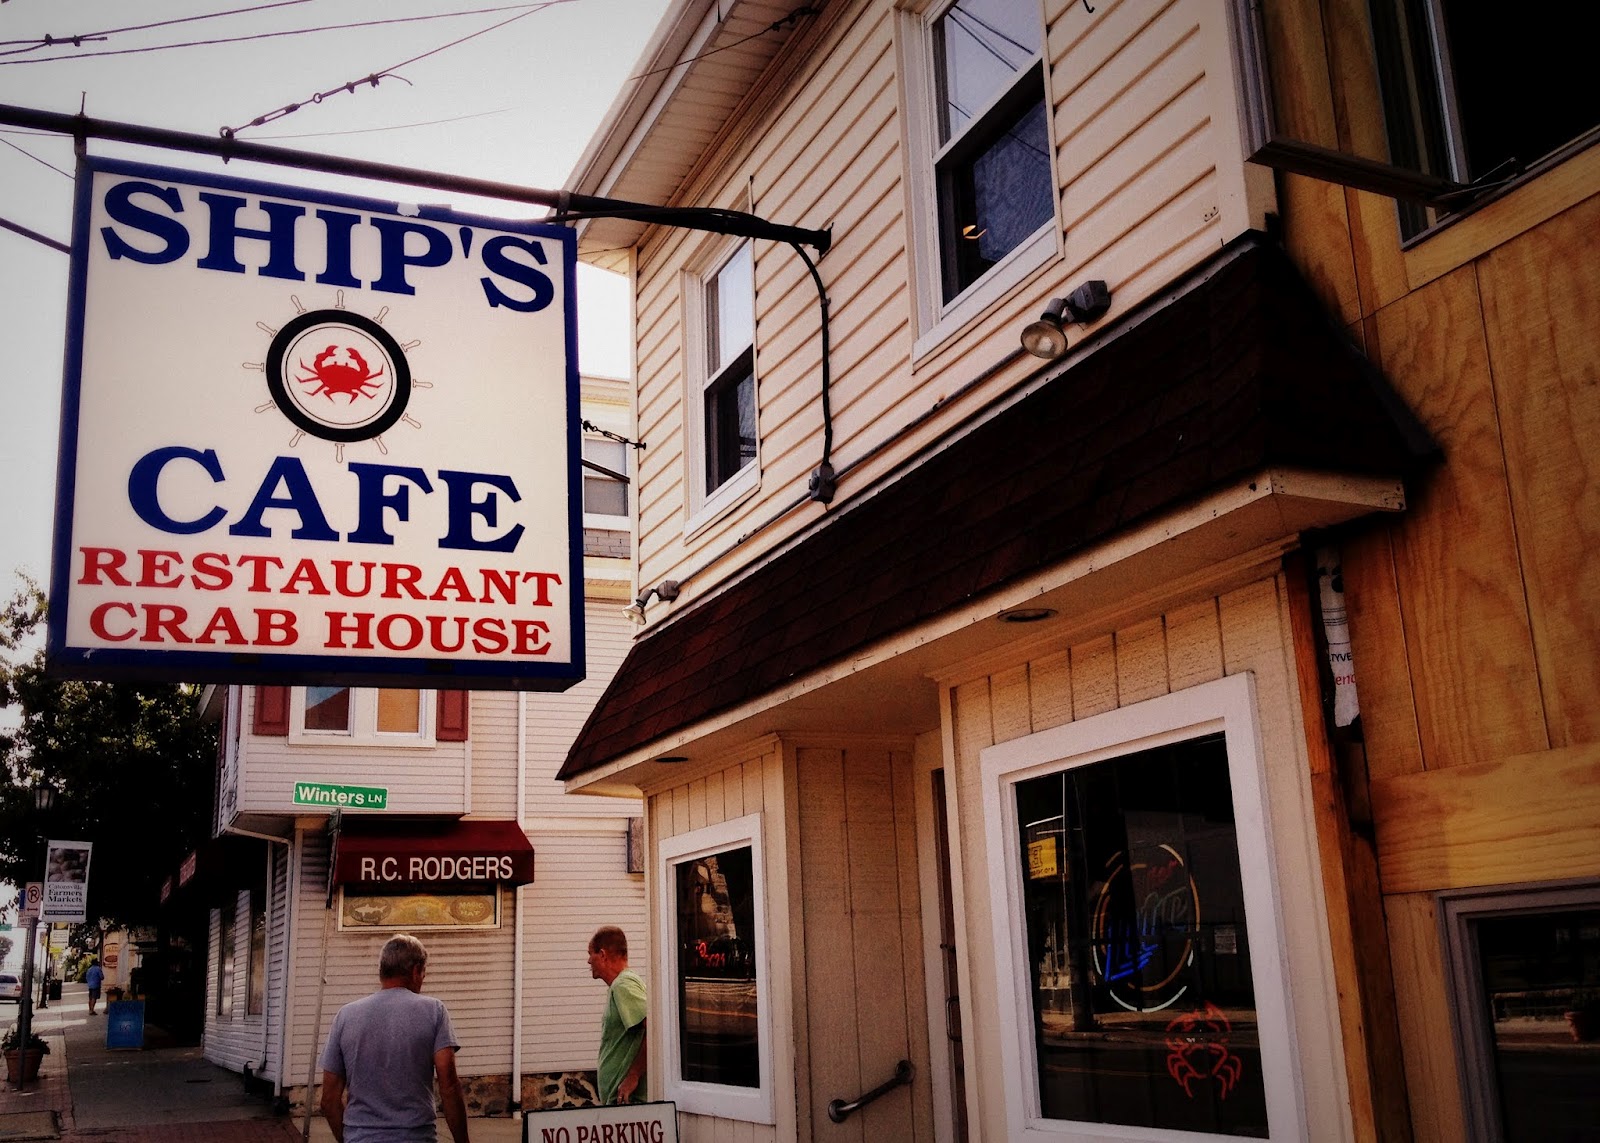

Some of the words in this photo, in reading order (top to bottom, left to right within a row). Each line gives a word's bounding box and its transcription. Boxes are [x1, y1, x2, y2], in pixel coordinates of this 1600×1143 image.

[99, 180, 555, 313] SHIP'S
[127, 445, 526, 553] CAFE
[77, 546, 563, 607] RESTAURANT
[89, 601, 299, 646] CRAB
[323, 610, 552, 656] HOUSE
[298, 785, 365, 805] Winters
[368, 793, 383, 804] LN
[360, 856, 402, 881] R.C.
[409, 855, 514, 881] RODGERS
[48, 889, 83, 897] Farmers
[459, 901, 484, 909] MAGIC
[541, 1127, 571, 1143] NO
[576, 1120, 664, 1143] PARKING
